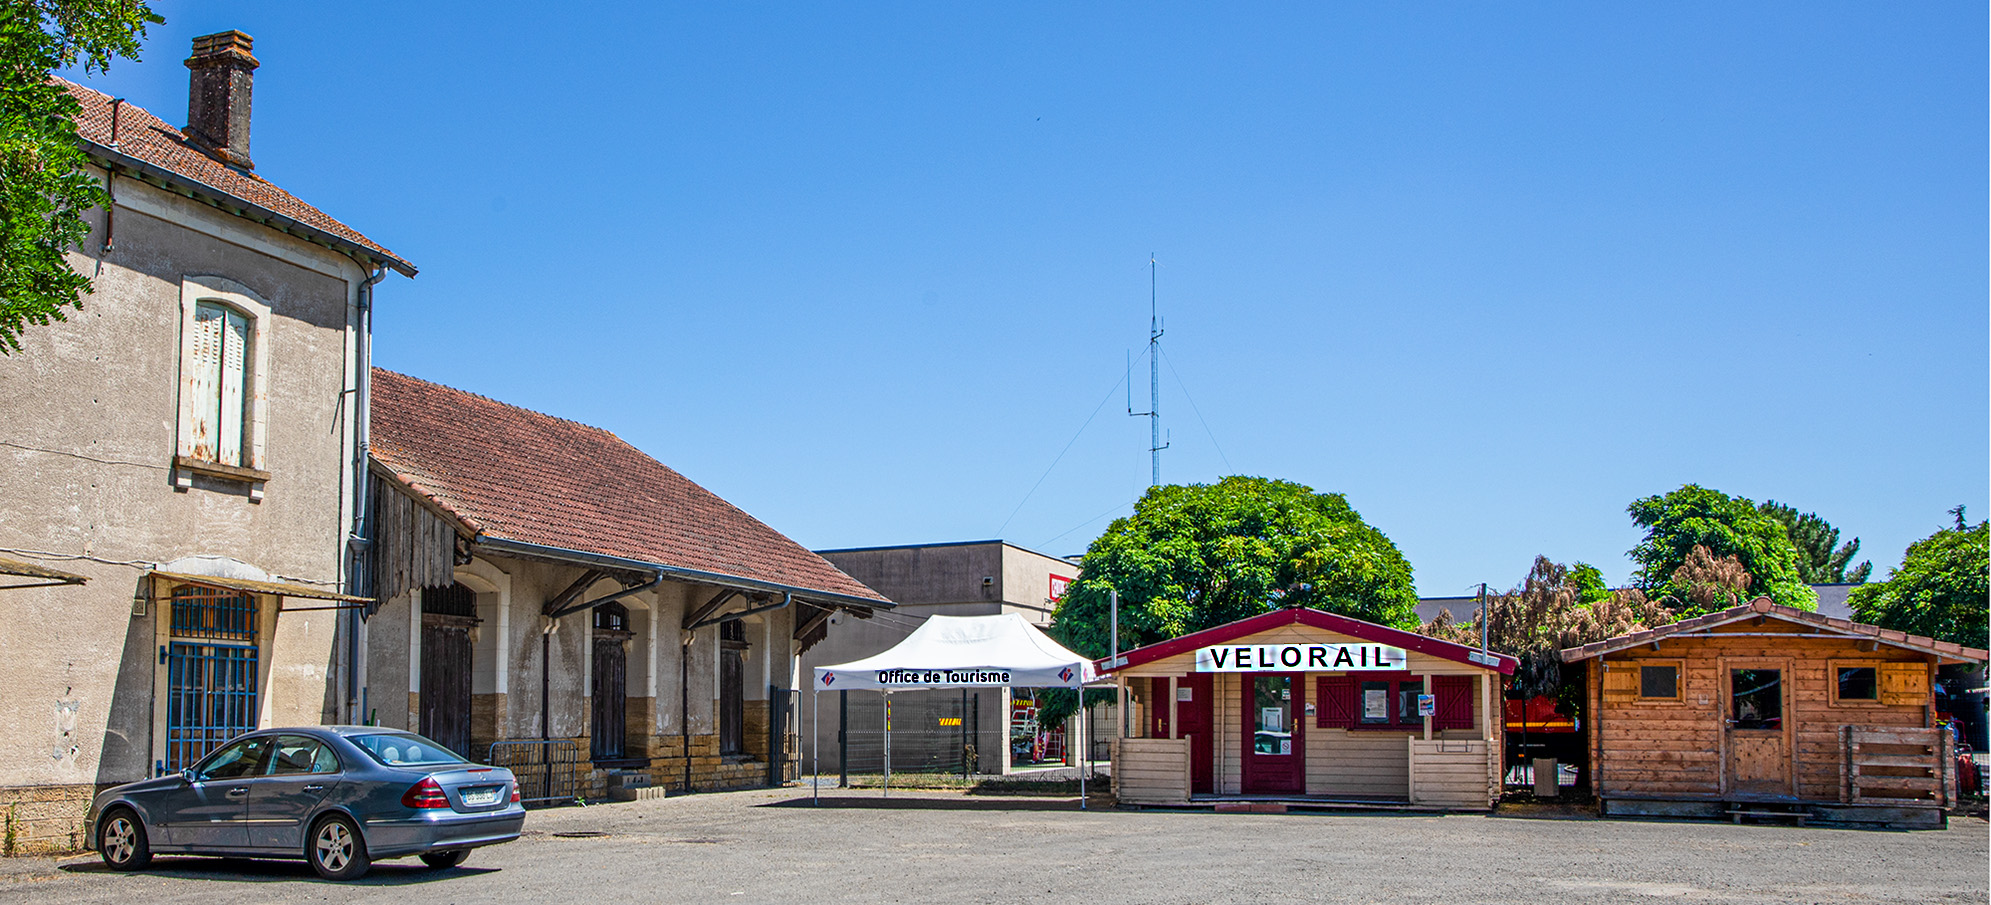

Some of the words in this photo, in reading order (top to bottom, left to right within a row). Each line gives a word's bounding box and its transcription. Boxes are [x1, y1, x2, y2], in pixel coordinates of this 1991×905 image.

[1210, 646, 1391, 669] VELORAIL
[878, 669, 920, 684] Office
[923, 669, 941, 683] de
[943, 669, 1010, 683] Tourisme
